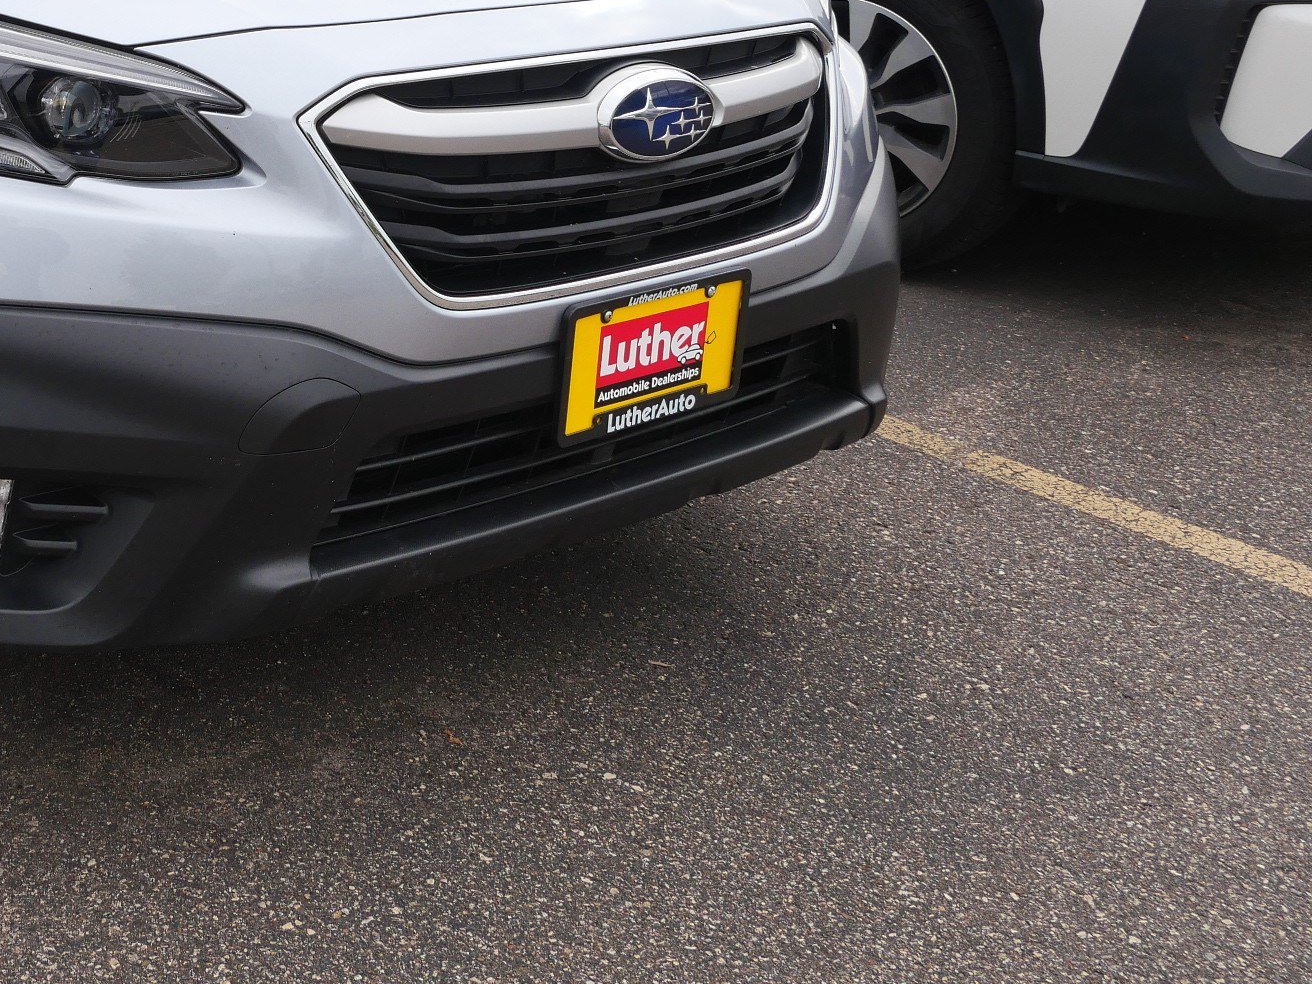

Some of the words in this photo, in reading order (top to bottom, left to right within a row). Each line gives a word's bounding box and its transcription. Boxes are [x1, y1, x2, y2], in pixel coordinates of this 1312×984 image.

[629, 284, 698, 306] LutherAuto.com
[600, 321, 705, 377] Luther
[597, 381, 650, 402] Automobile
[651, 367, 699, 389] Dealerships
[606, 393, 696, 434] LutherAuto
